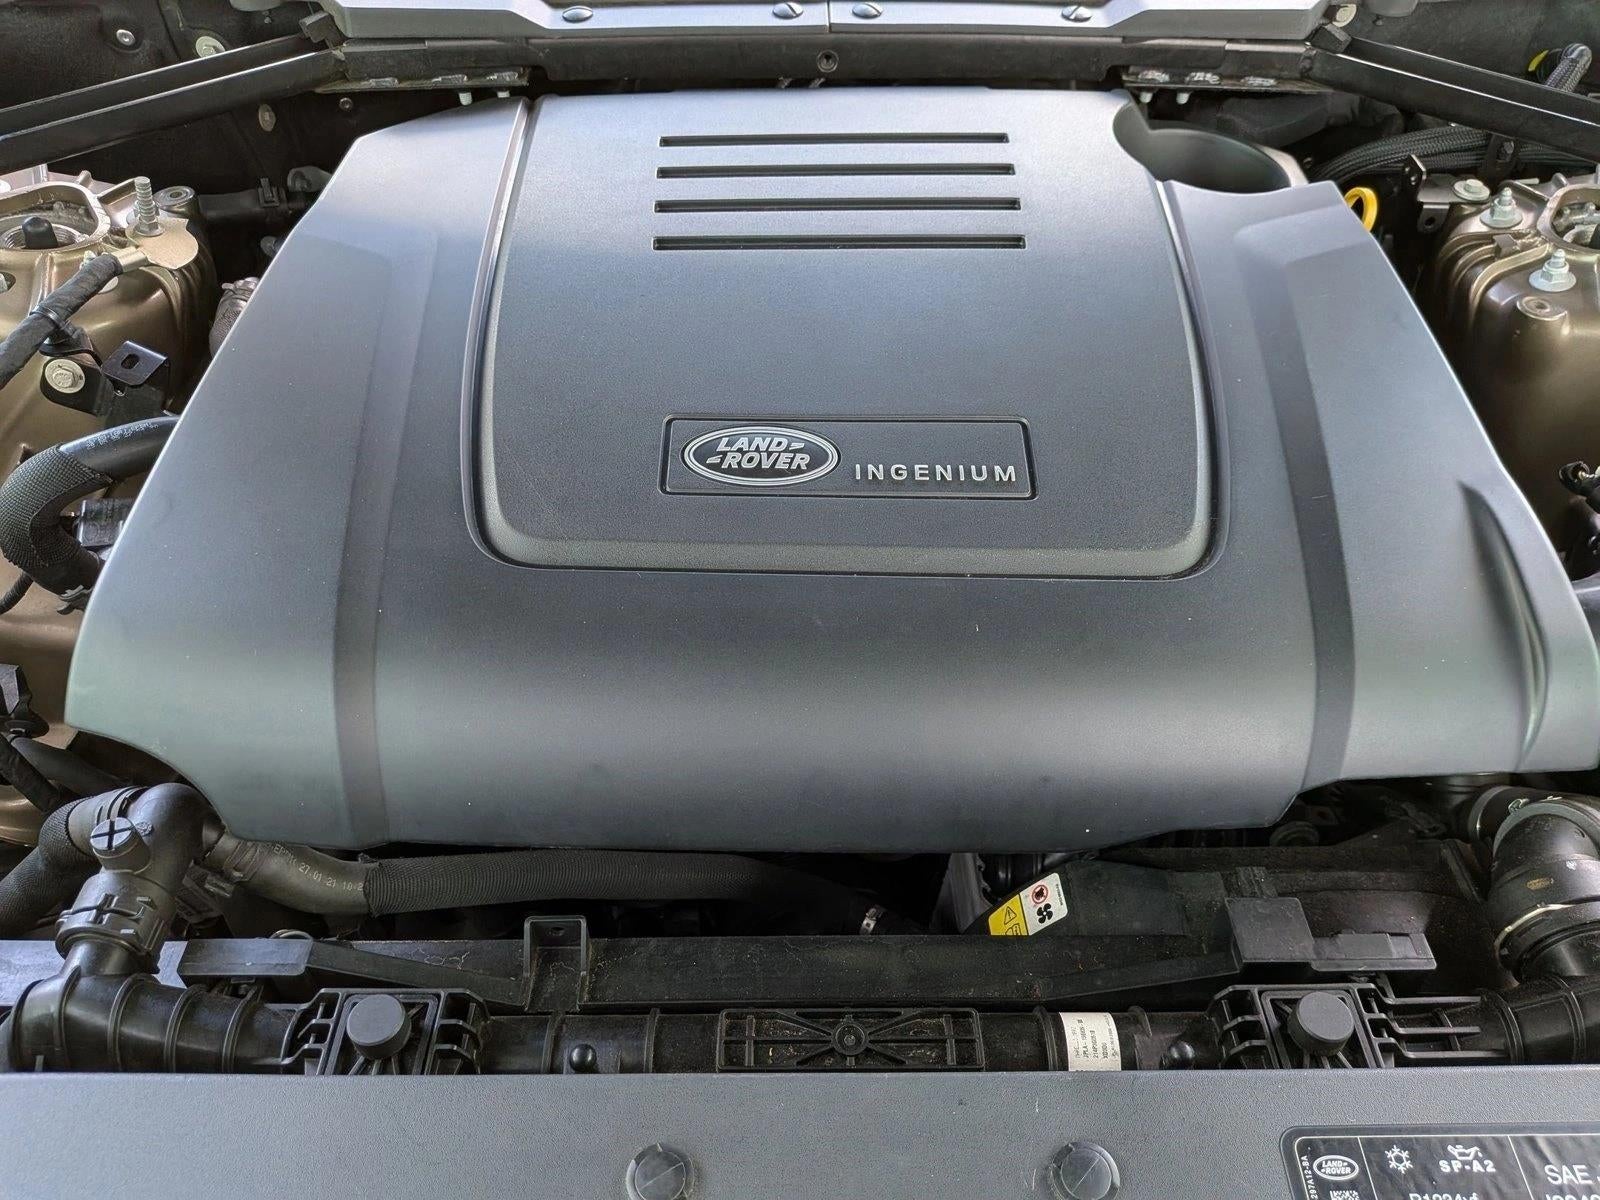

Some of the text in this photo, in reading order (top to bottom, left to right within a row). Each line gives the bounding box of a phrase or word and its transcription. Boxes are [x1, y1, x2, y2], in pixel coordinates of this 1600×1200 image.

[716, 437, 788, 452] LAND
[721, 452, 811, 470] ROVER
[855, 464, 1016, 482] INGENIUM
[1322, 1160, 1343, 1168] LAND
[1325, 1167, 1351, 1175] ROVER
[1439, 1160, 1496, 1173] SP-A2
[1544, 1164, 1593, 1185] SAE
